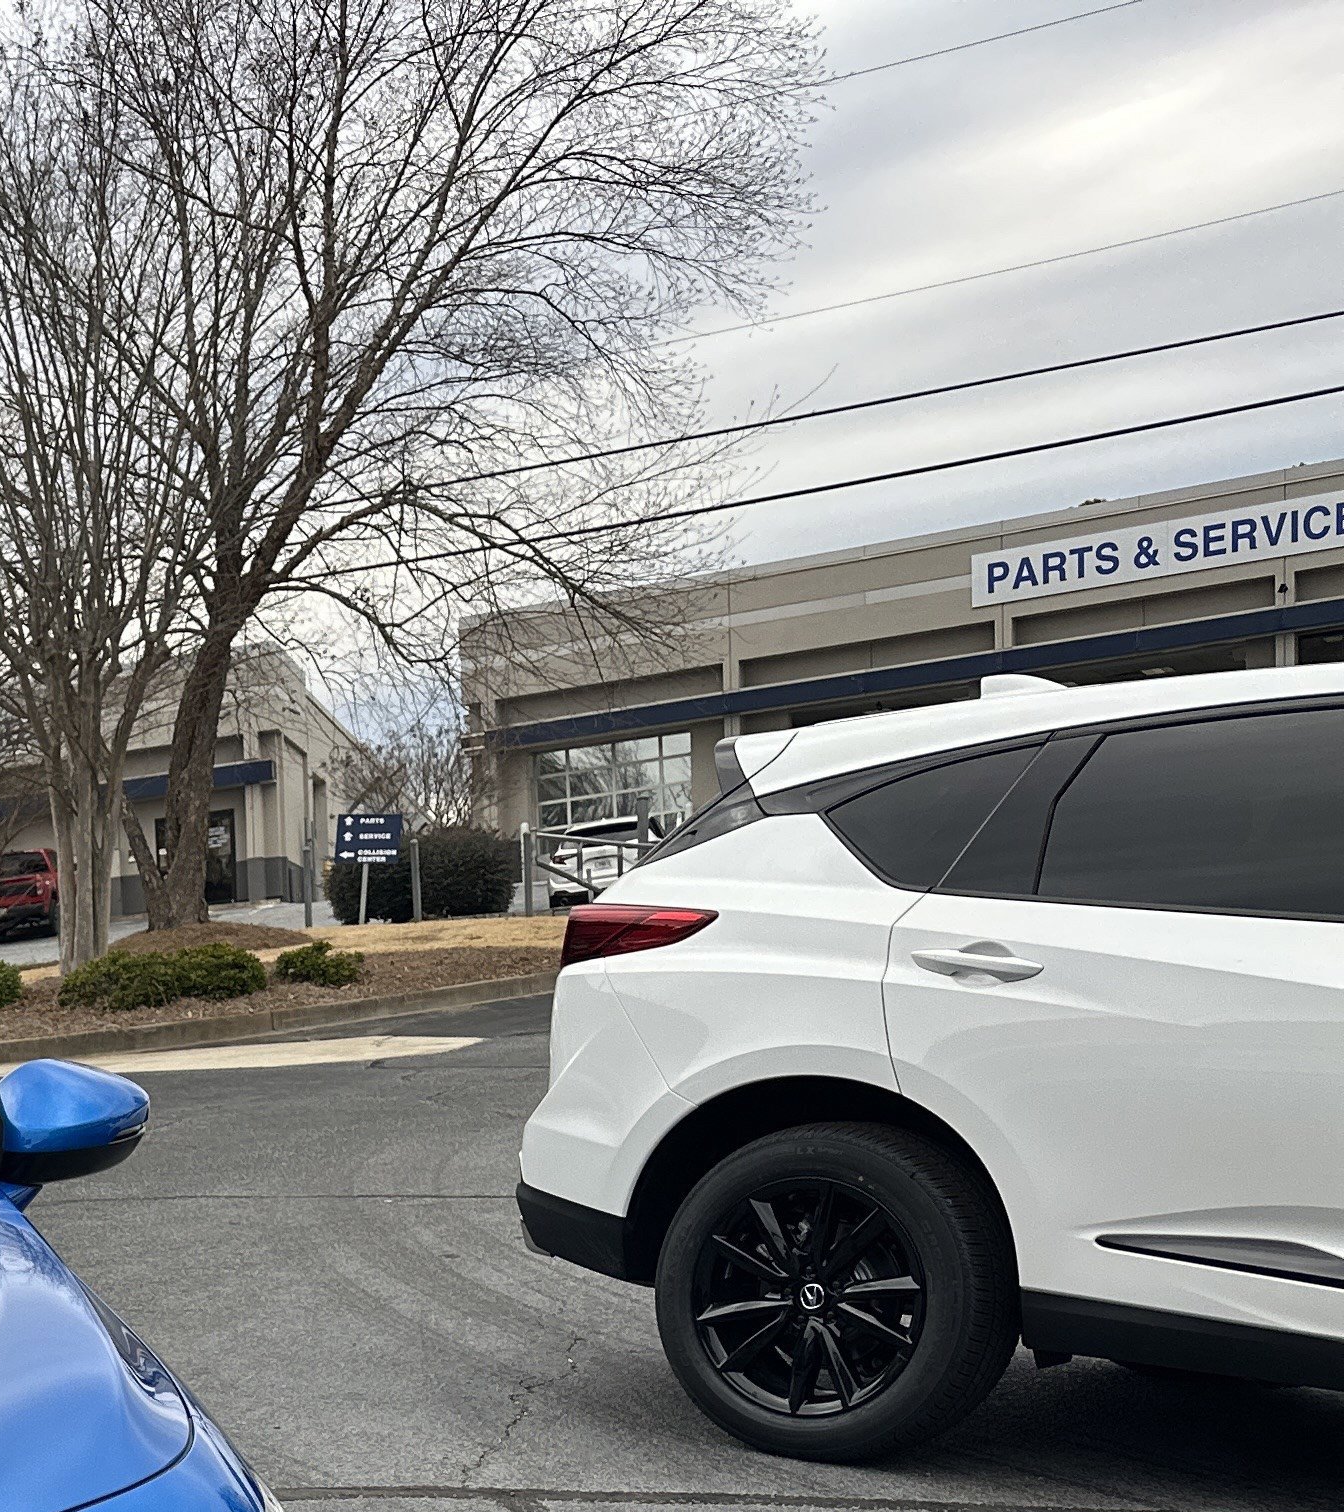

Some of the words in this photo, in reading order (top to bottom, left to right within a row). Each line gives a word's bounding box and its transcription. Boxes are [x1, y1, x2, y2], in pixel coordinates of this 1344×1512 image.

[987, 542, 1120, 594] PARTS
[1133, 536, 1161, 569] &
[359, 832, 392, 840] SERVICE
